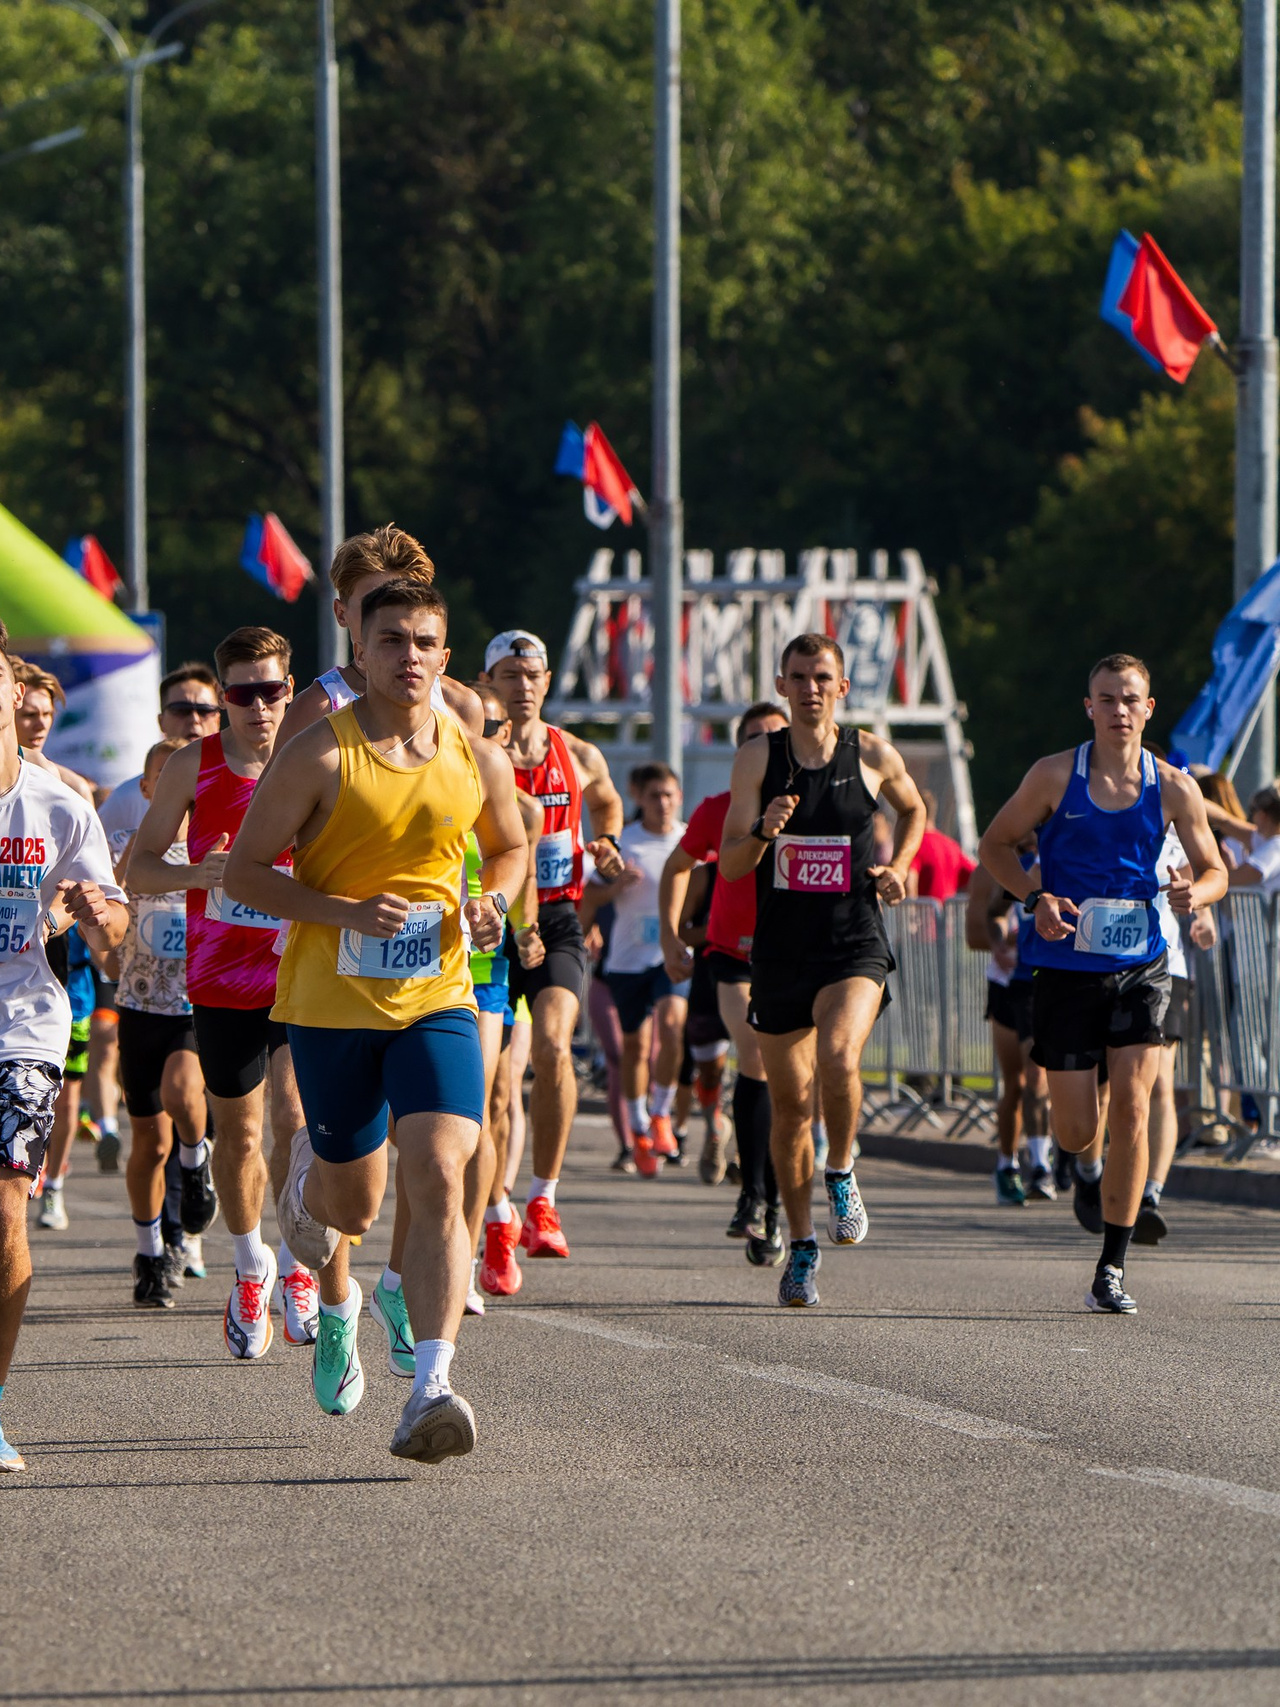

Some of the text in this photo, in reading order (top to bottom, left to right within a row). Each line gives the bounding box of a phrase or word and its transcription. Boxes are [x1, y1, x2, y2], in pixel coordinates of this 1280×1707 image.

[797, 850, 844, 862] АЛЕКСАНДР
[797, 863, 844, 886] 4224
[397, 919, 428, 936] ЕКСЕЙ
[1109, 913, 1137, 924] ПЛАТОН
[162, 930, 187, 952] 22
[1101, 926, 1142, 948] 3467
[380, 937, 432, 969] 1285
